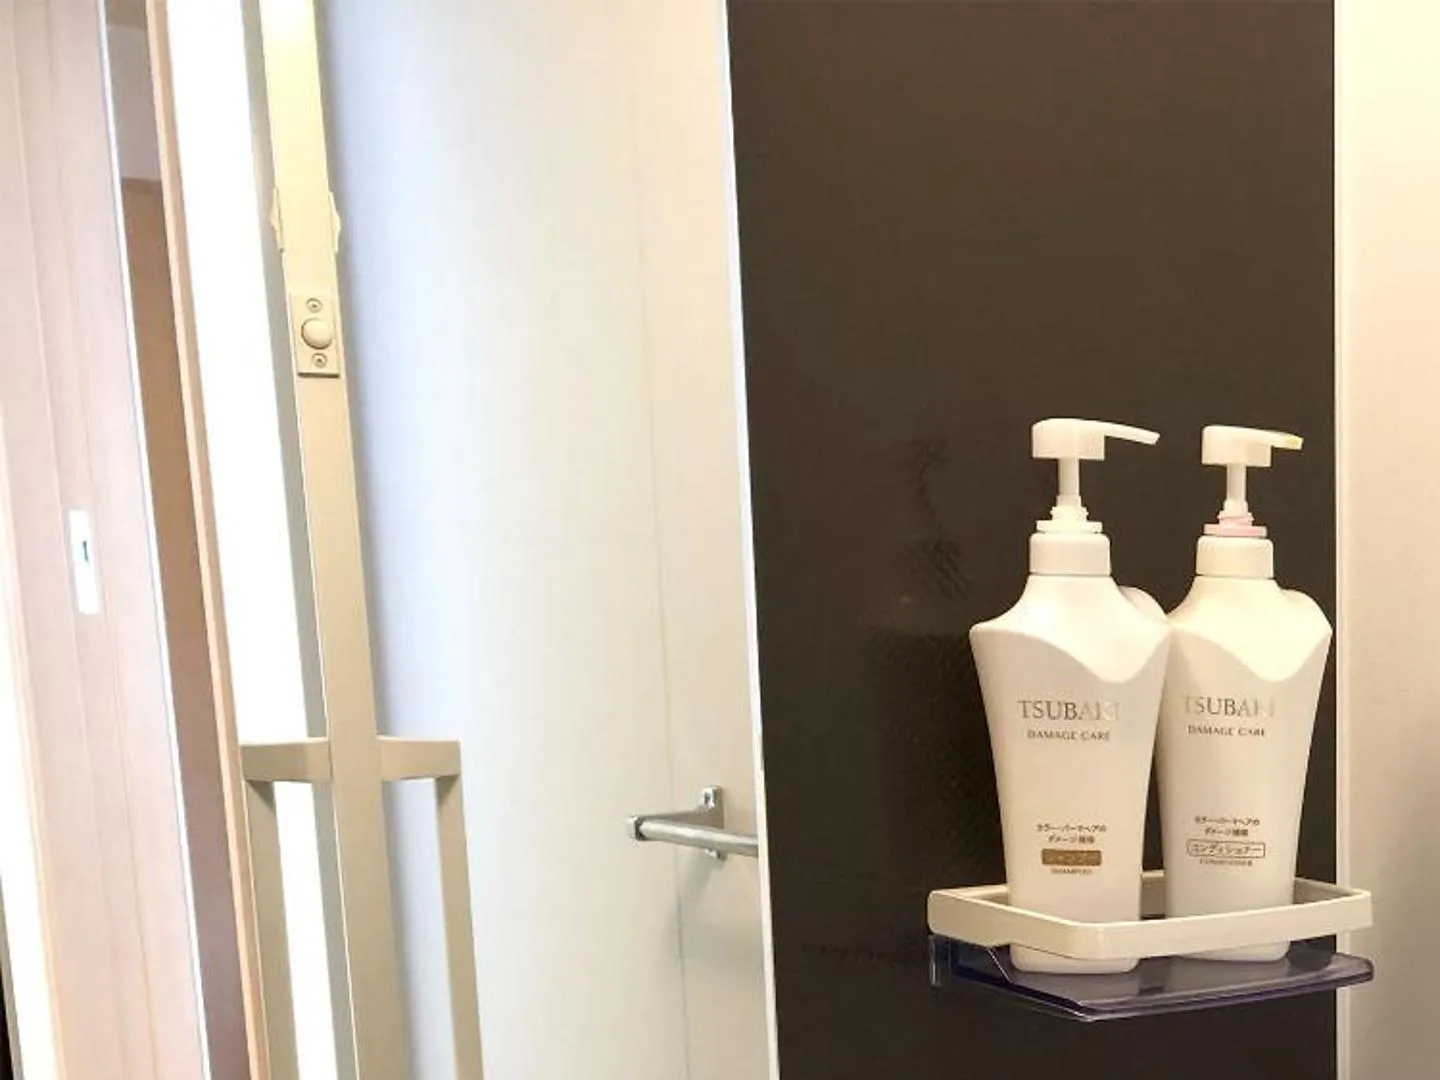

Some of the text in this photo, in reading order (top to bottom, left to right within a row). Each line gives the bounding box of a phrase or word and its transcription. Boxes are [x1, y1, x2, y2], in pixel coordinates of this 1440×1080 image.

[1017, 699, 1120, 720] TSUBAKI
[1183, 695, 1274, 716] TSUBAKI
[1027, 730, 1110, 741] DAMAGE CARE
[1187, 725, 1265, 737] DAMAGE CARE
